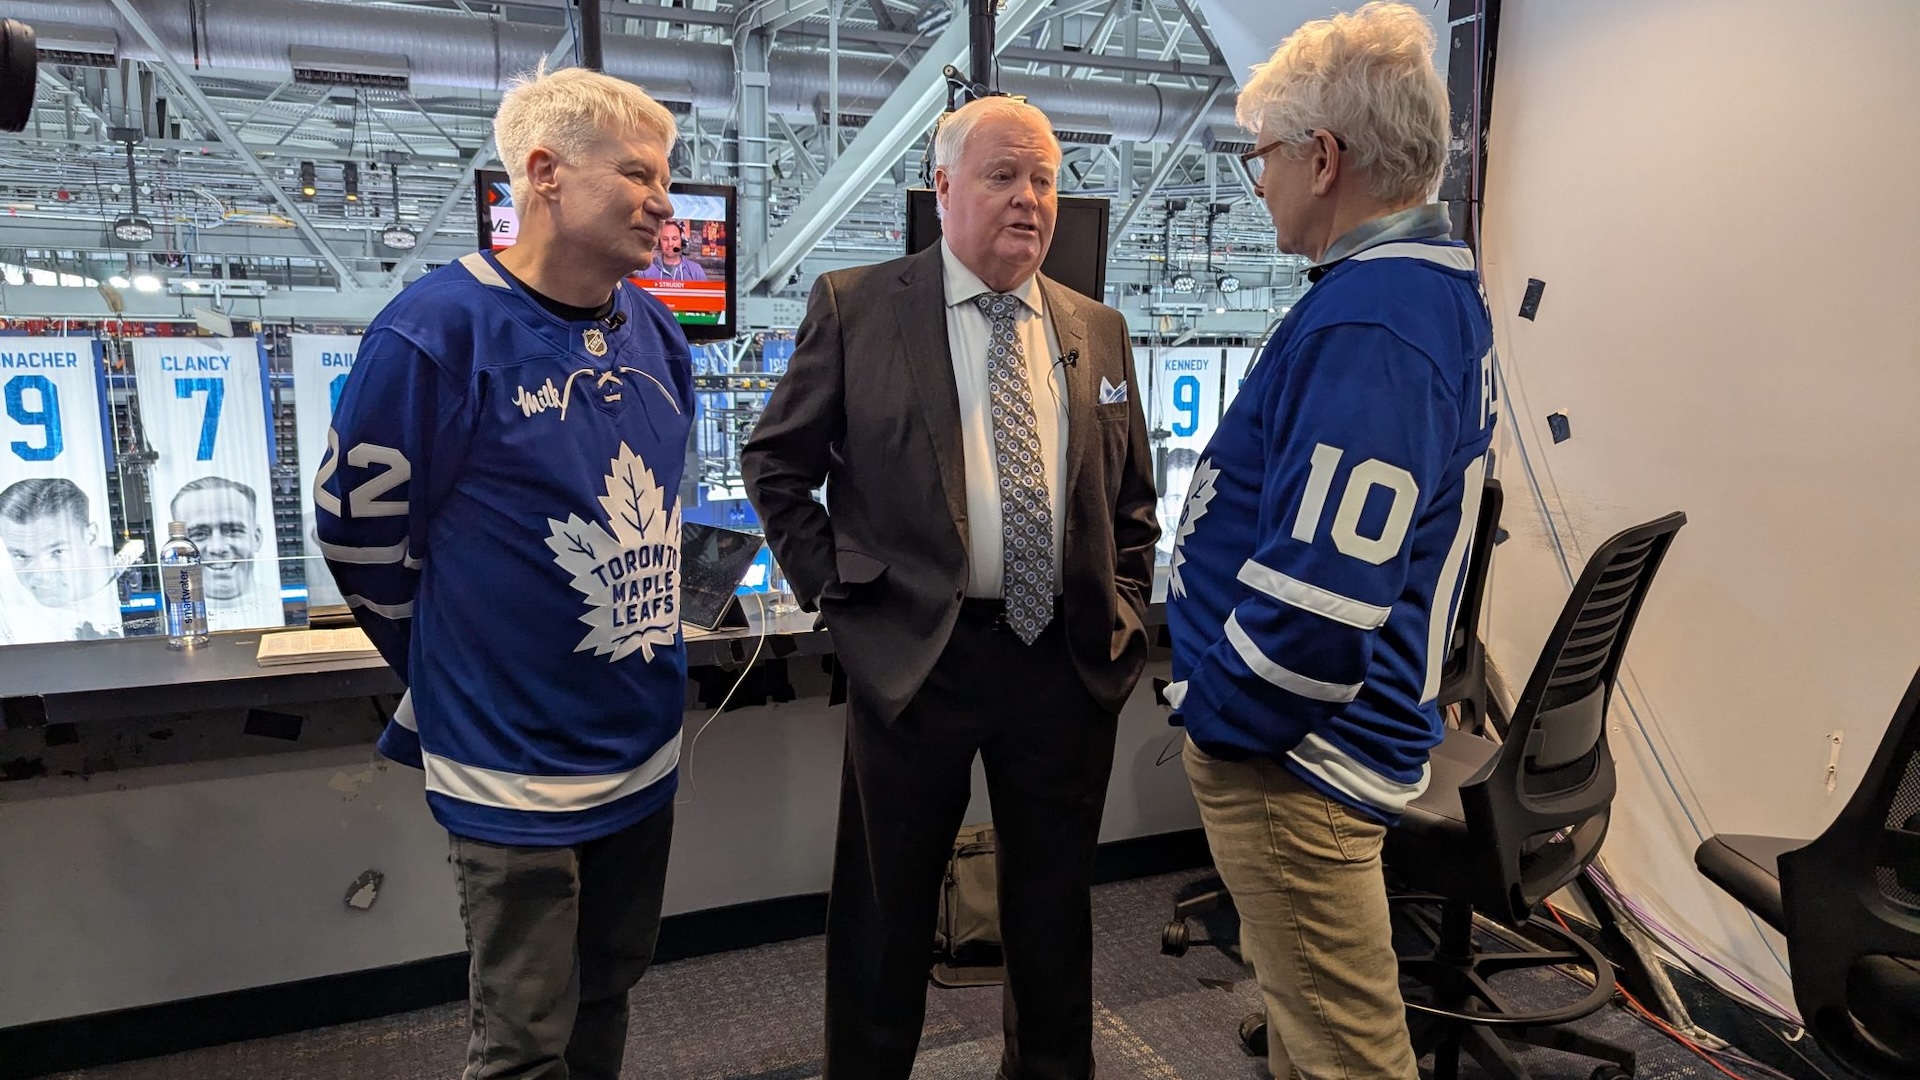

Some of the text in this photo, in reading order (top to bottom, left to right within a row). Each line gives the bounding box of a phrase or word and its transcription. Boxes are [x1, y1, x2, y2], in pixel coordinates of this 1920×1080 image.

[0, 352, 77, 368] NACHER
[161, 355, 231, 371] CLANCY
[1165, 359, 1209, 371] KENNEDY
[4, 375, 64, 461] 9
[174, 377, 224, 461] 7
[512, 377, 563, 418] Milk
[1172, 375, 1200, 437] 9
[313, 425, 411, 518] 22
[1292, 442, 1420, 566] 10
[590, 544, 678, 588] TORONTO
[612, 570, 674, 603] MAPLE
[1418, 455, 1484, 706] 1
[180, 569, 193, 624] smartwater
[612, 594, 674, 627] LEAFS
